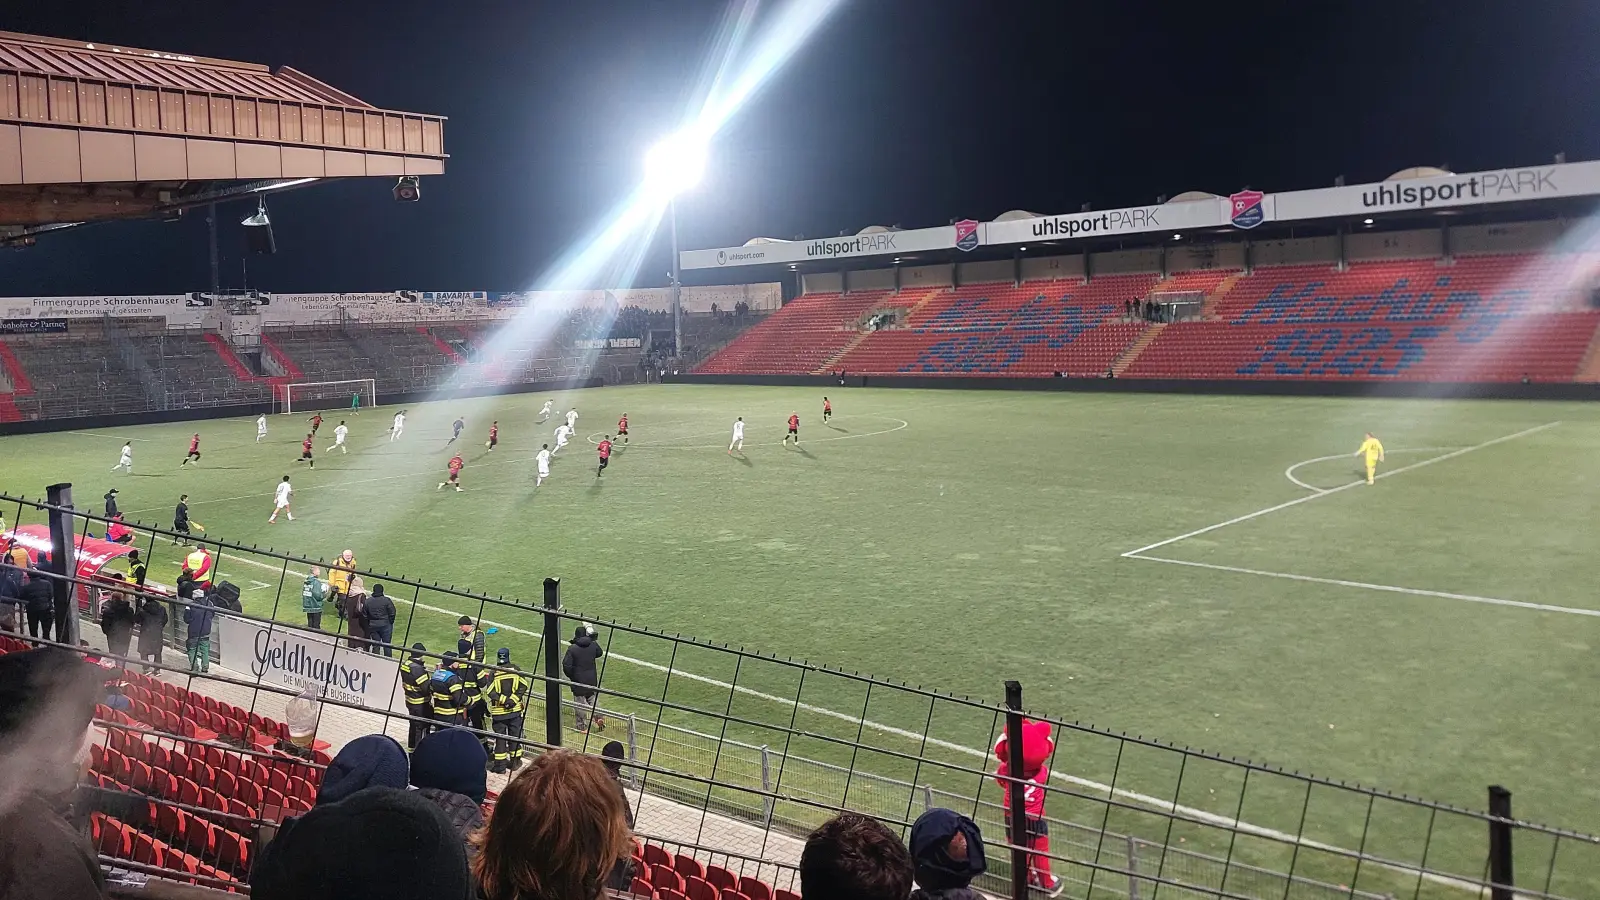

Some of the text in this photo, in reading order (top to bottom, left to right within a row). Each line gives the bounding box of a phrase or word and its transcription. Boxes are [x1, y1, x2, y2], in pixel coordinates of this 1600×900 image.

[1362, 168, 1558, 207] uhlsportPARK
[1032, 208, 1160, 237] uhlsportPARK
[807, 234, 896, 258] uhlsportPARK
[729, 251, 765, 261] uhlsport.com
[436, 292, 471, 300] BAVARIA
[33, 298, 101, 308] Firmengruppe
[103, 297, 179, 306] Schrobenhauser
[118, 308, 152, 316] gestalten
[251, 629, 371, 694] Geldhauser
[283, 674, 293, 686] DIE
